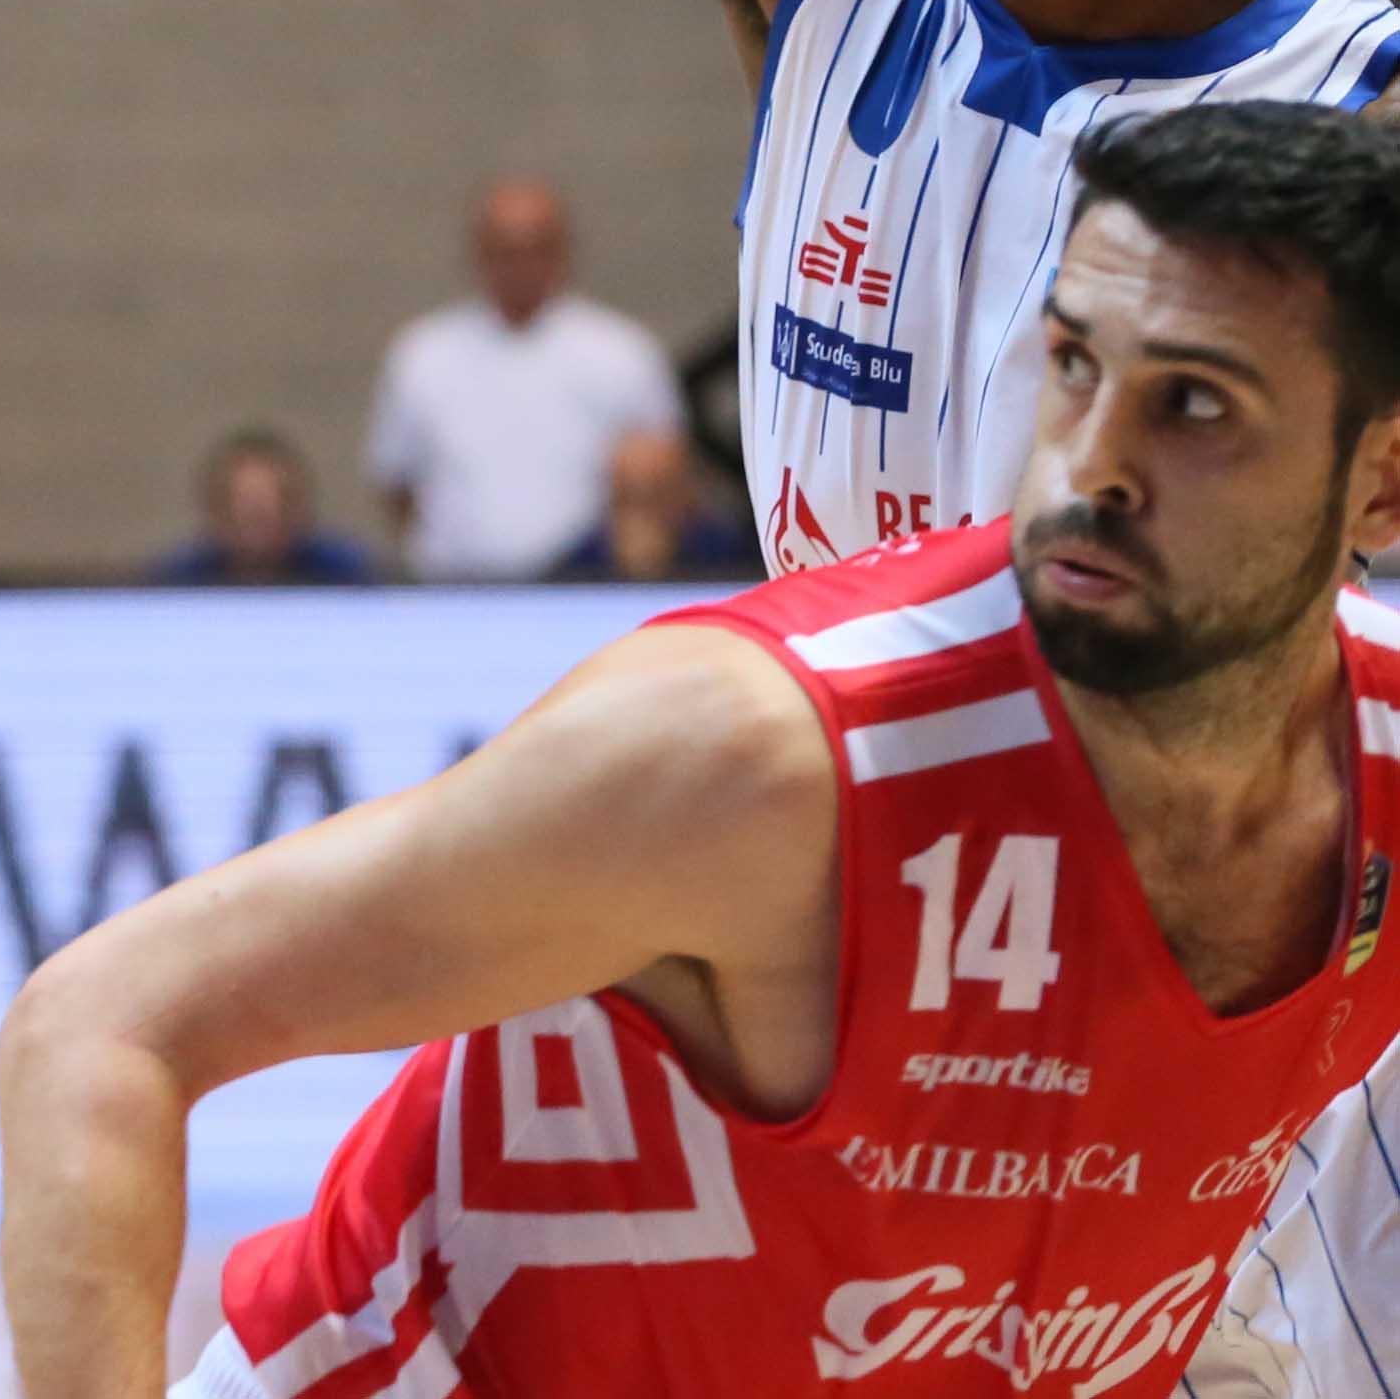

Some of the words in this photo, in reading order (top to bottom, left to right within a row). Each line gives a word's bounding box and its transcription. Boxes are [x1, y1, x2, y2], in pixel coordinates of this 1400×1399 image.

[870, 357, 903, 385] Blu
[901, 833, 1062, 1011] 14
[902, 1052, 1091, 1096] sportike
